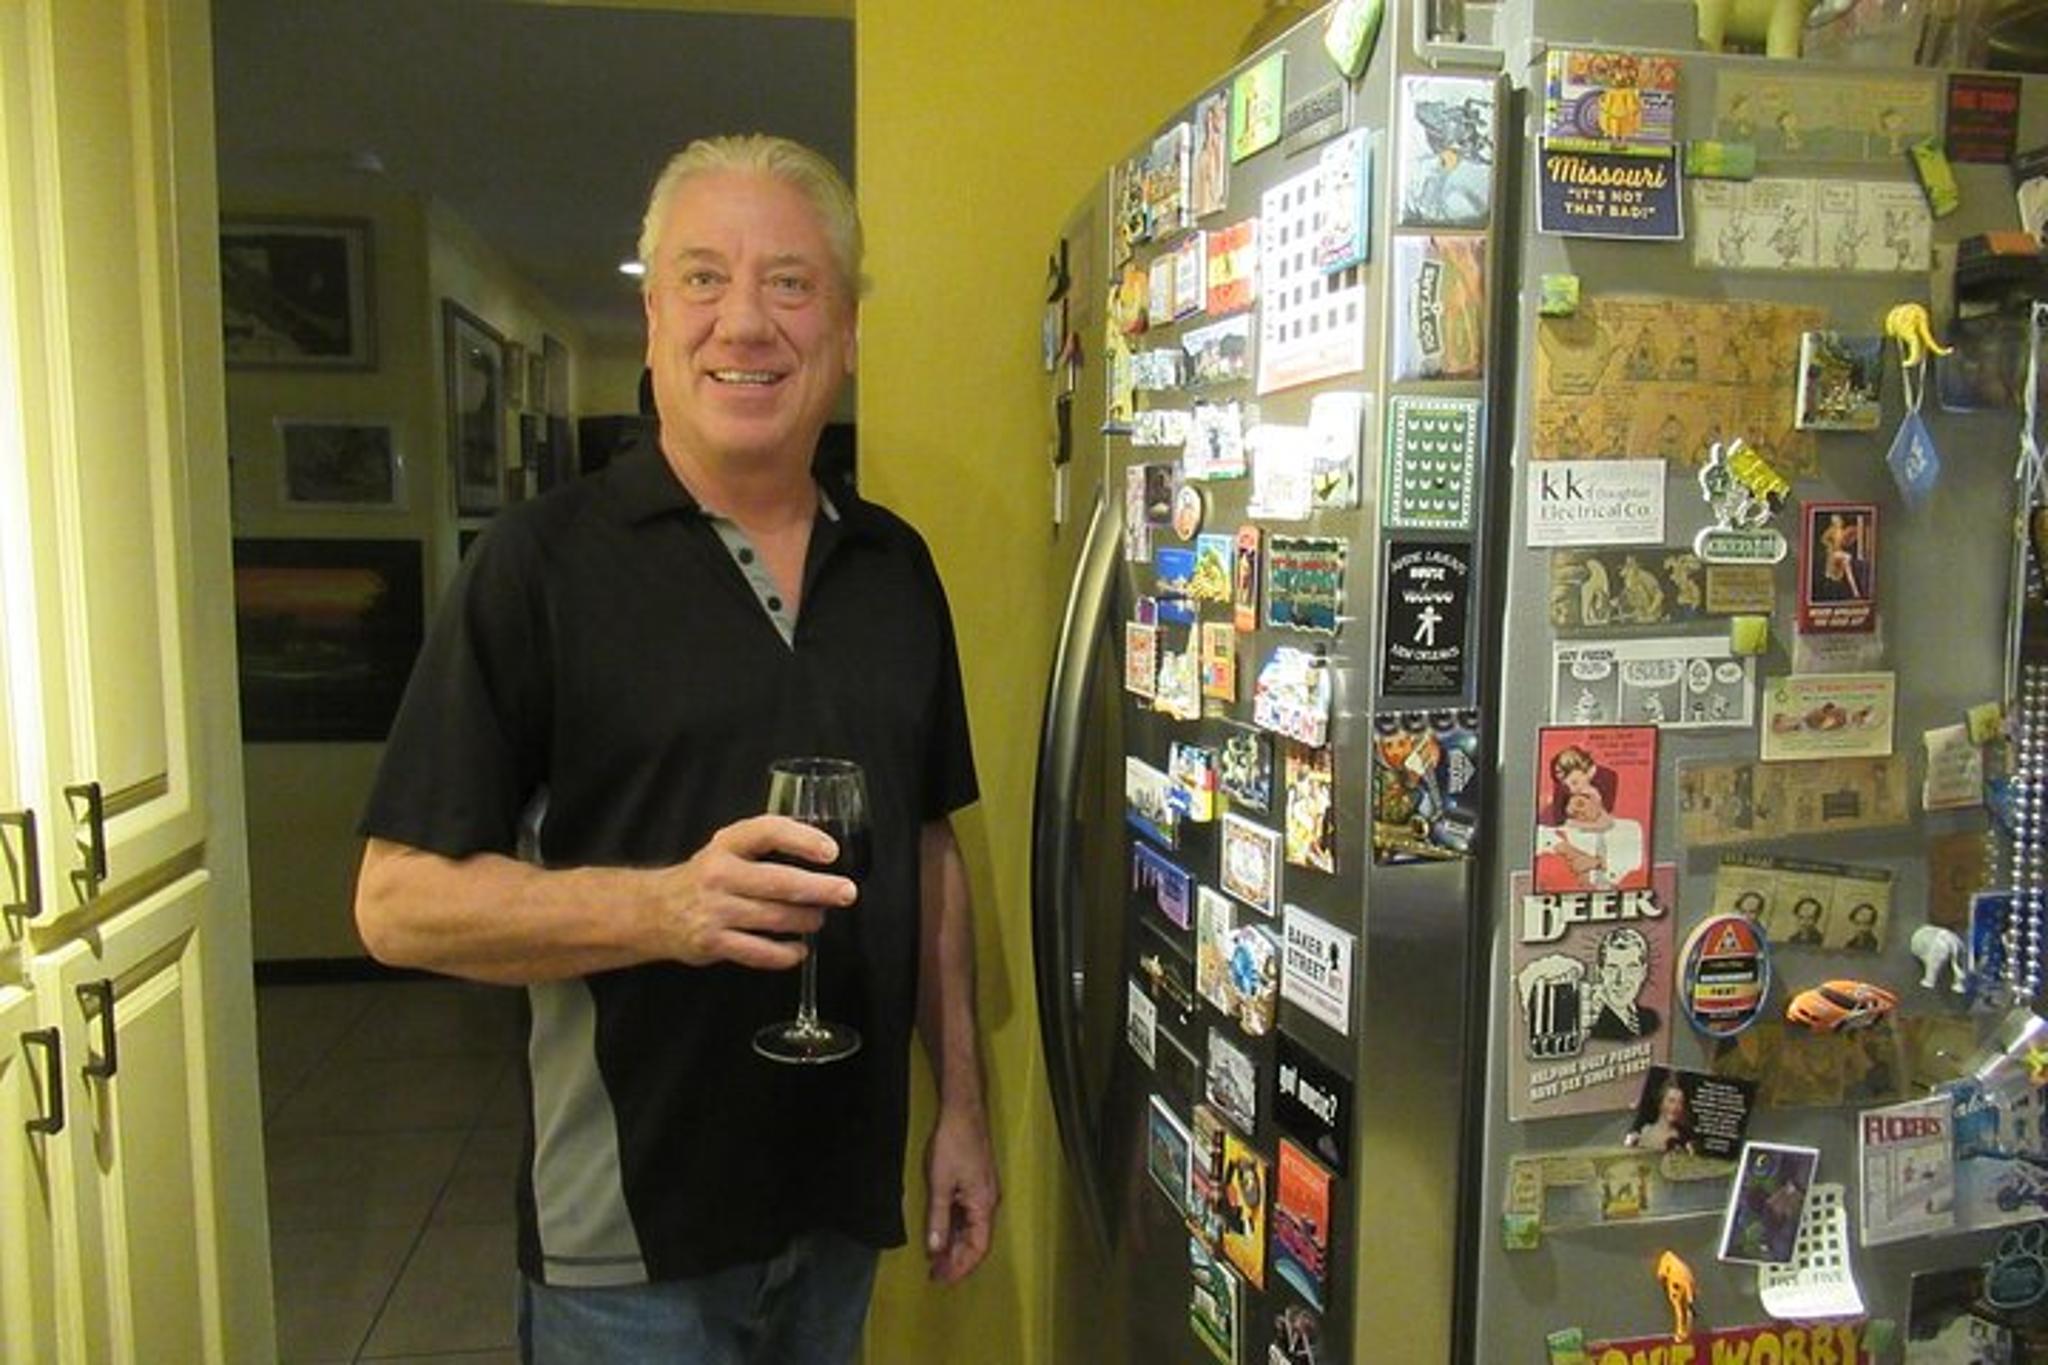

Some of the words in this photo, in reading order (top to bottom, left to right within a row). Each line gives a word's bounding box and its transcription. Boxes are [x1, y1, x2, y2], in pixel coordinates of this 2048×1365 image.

[1547, 155, 1667, 189] Missouri
[1564, 202, 1605, 217] THAT
[1611, 189, 1643, 204] NOT
[1523, 889, 1663, 942] BEER
[1288, 924, 1324, 959] BAKER
[1288, 946, 1327, 982] STREET
